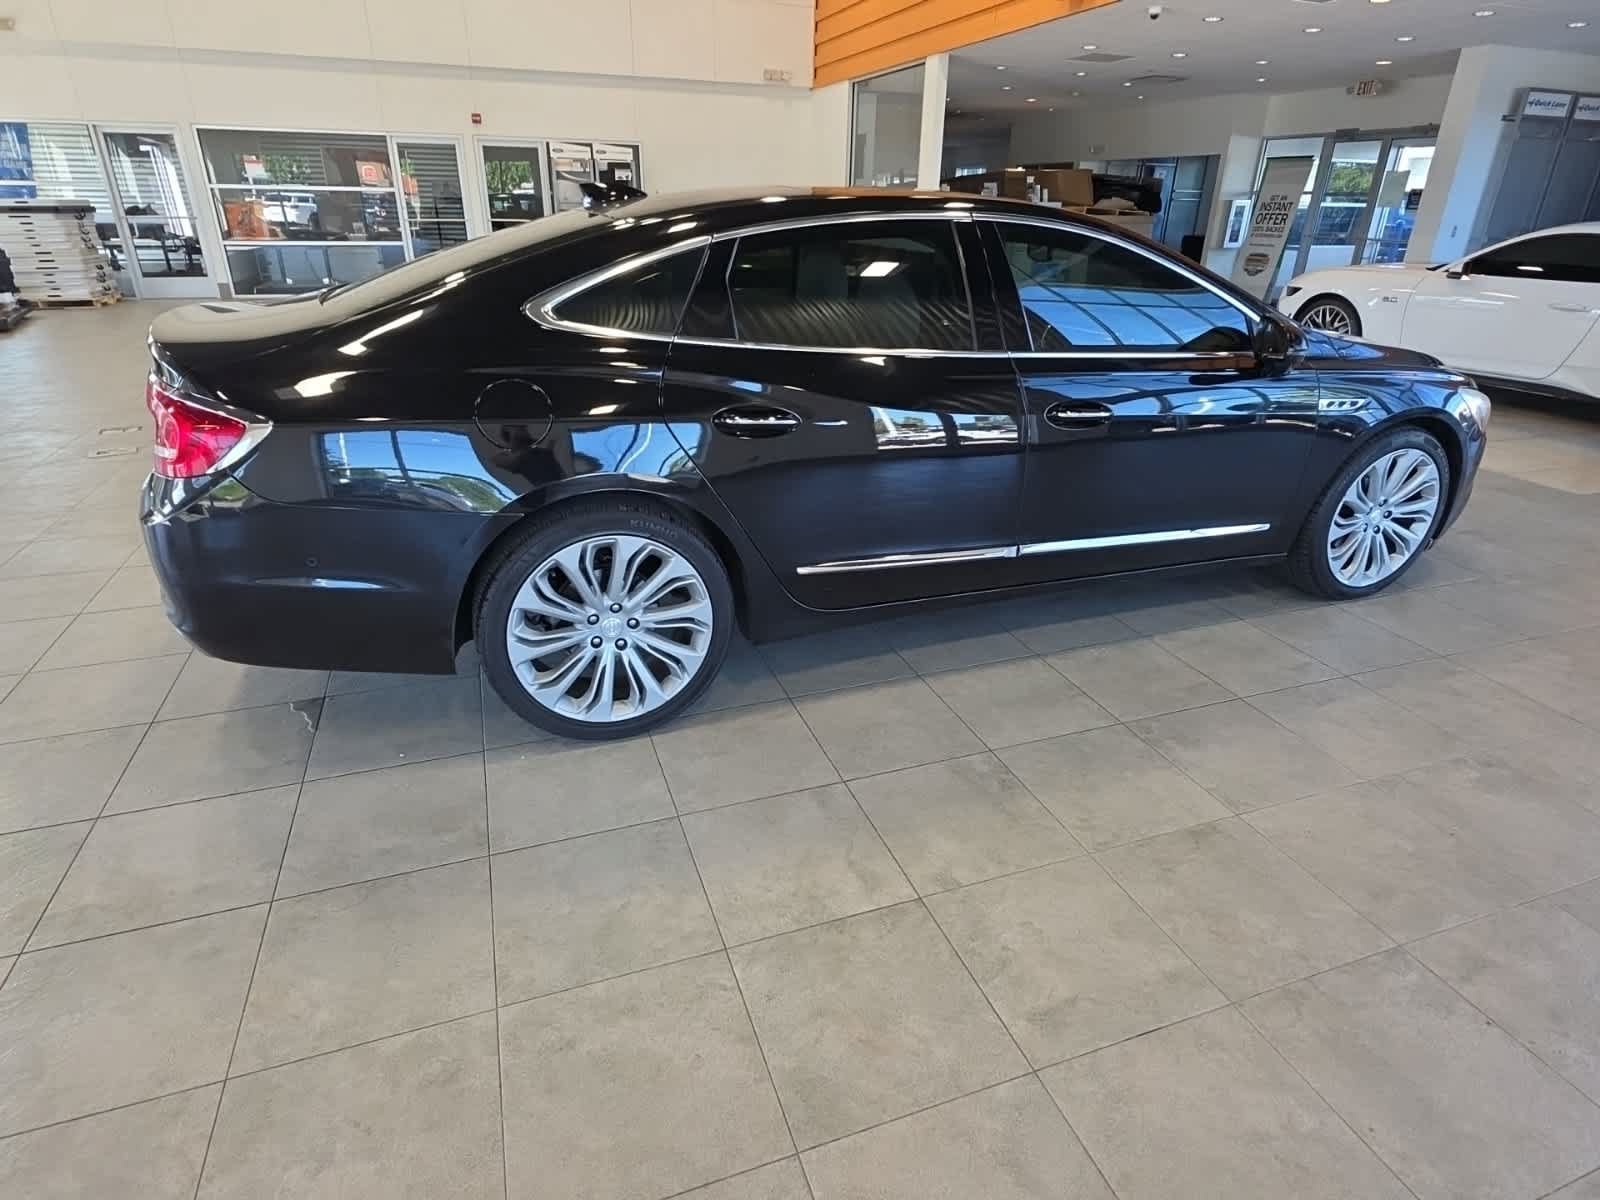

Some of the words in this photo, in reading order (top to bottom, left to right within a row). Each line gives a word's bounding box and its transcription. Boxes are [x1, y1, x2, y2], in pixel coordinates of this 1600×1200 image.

[1356, 80, 1374, 95] EXIT
[1259, 202, 1294, 211] INSTANT
[1255, 213, 1289, 225] OFFER
